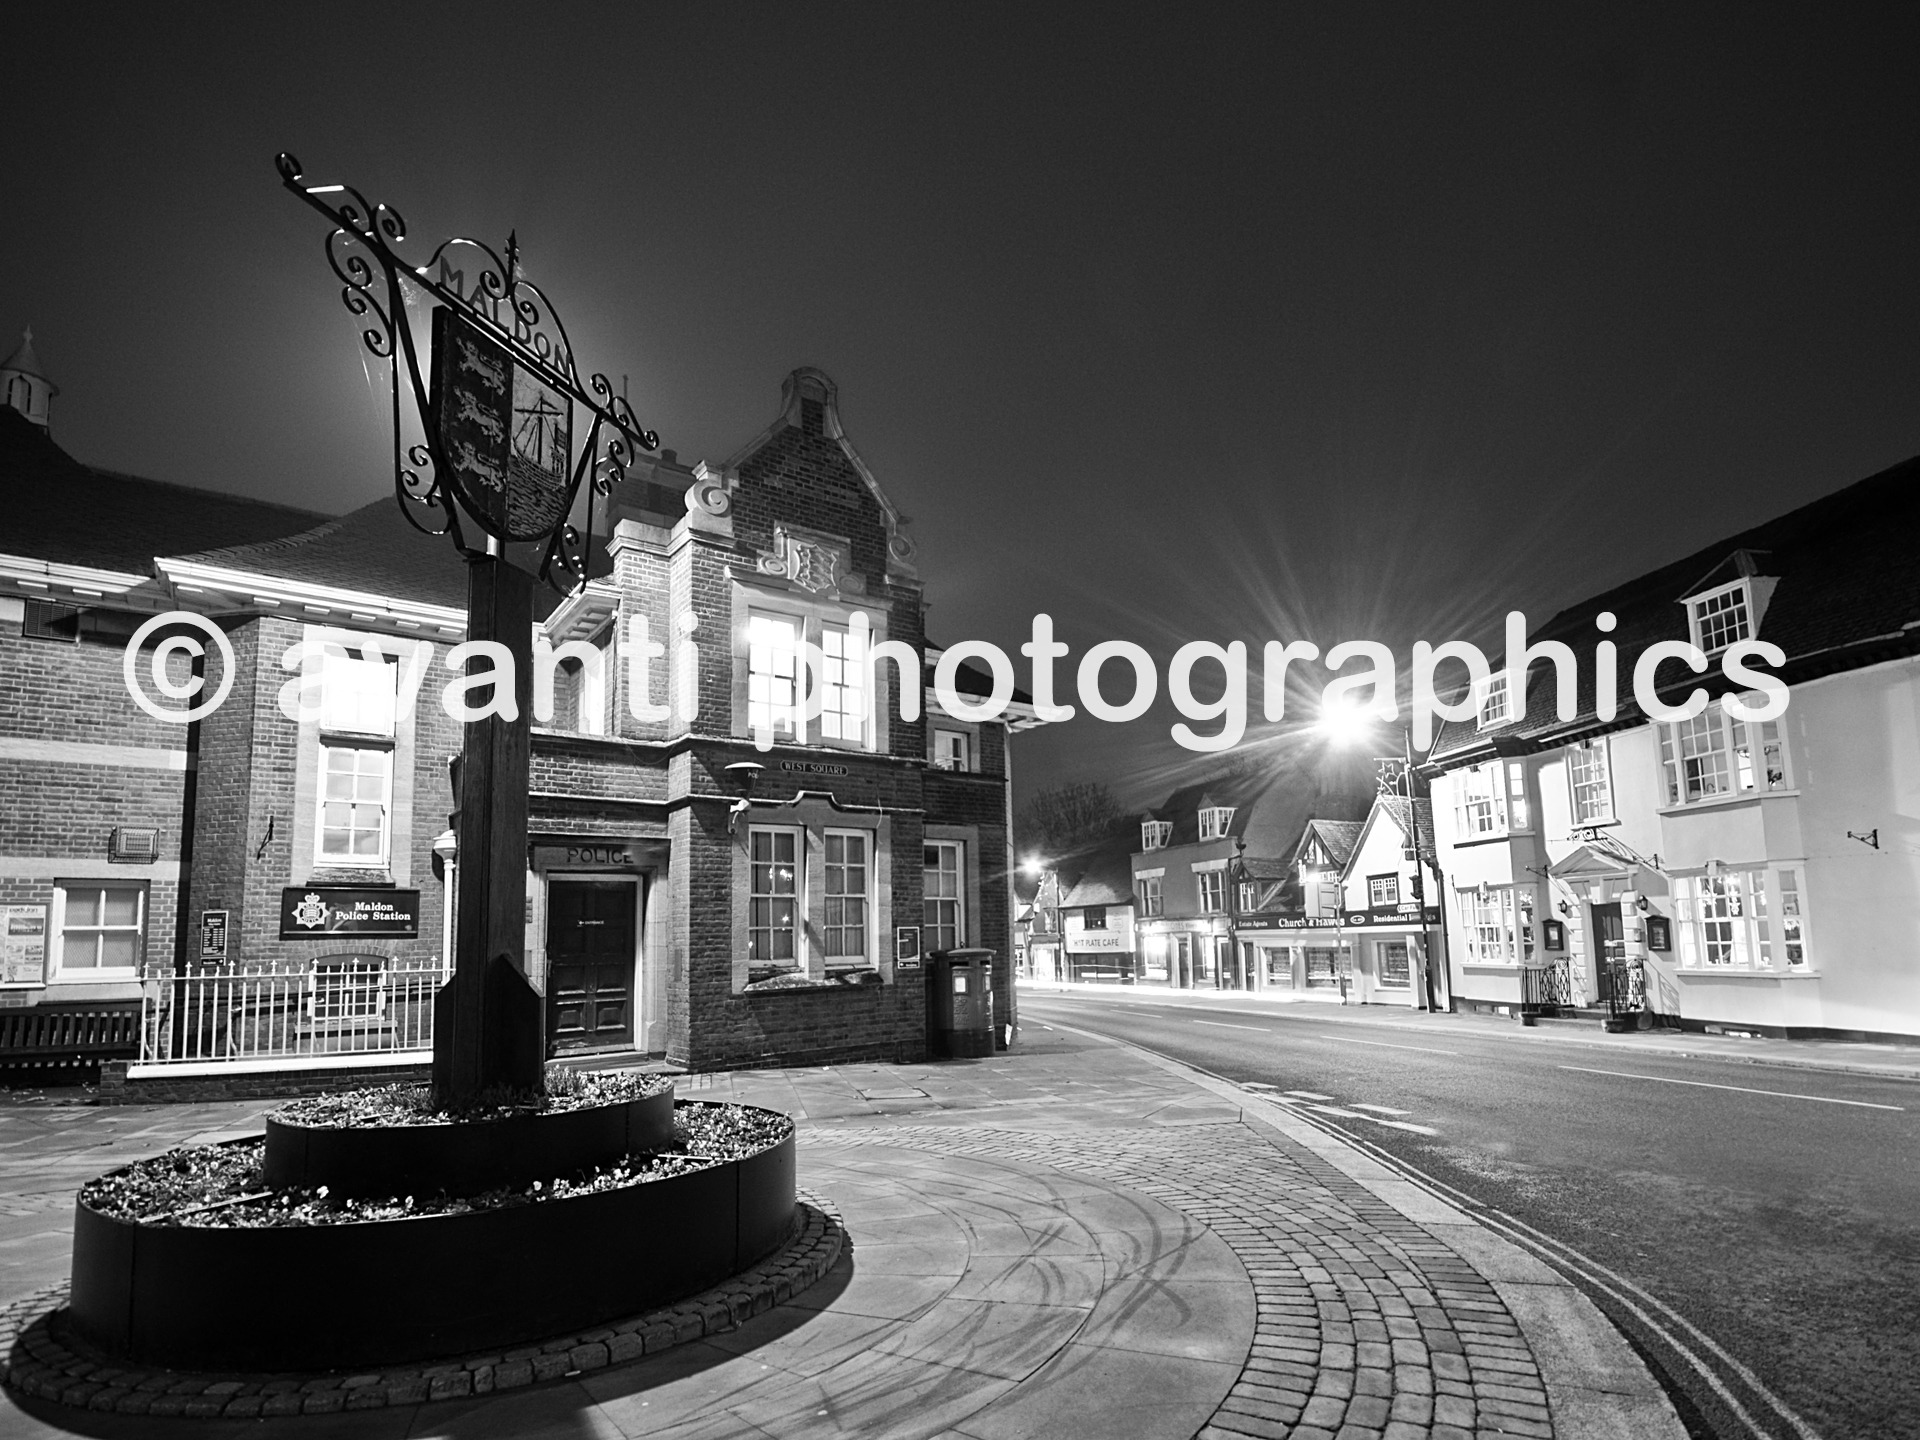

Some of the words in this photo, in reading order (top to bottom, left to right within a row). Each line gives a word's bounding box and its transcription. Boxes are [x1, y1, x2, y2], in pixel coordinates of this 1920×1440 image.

[440, 255, 573, 377] MALDON
[785, 762, 806, 771] WEST
[811, 764, 844, 775] SQUARE
[567, 847, 634, 864] POLICE
[355, 902, 394, 911] Maldon
[335, 911, 369, 921] Police
[373, 911, 411, 921] Station
[1373, 913, 1408, 923] Residential
[1278, 917, 1307, 928] Church
